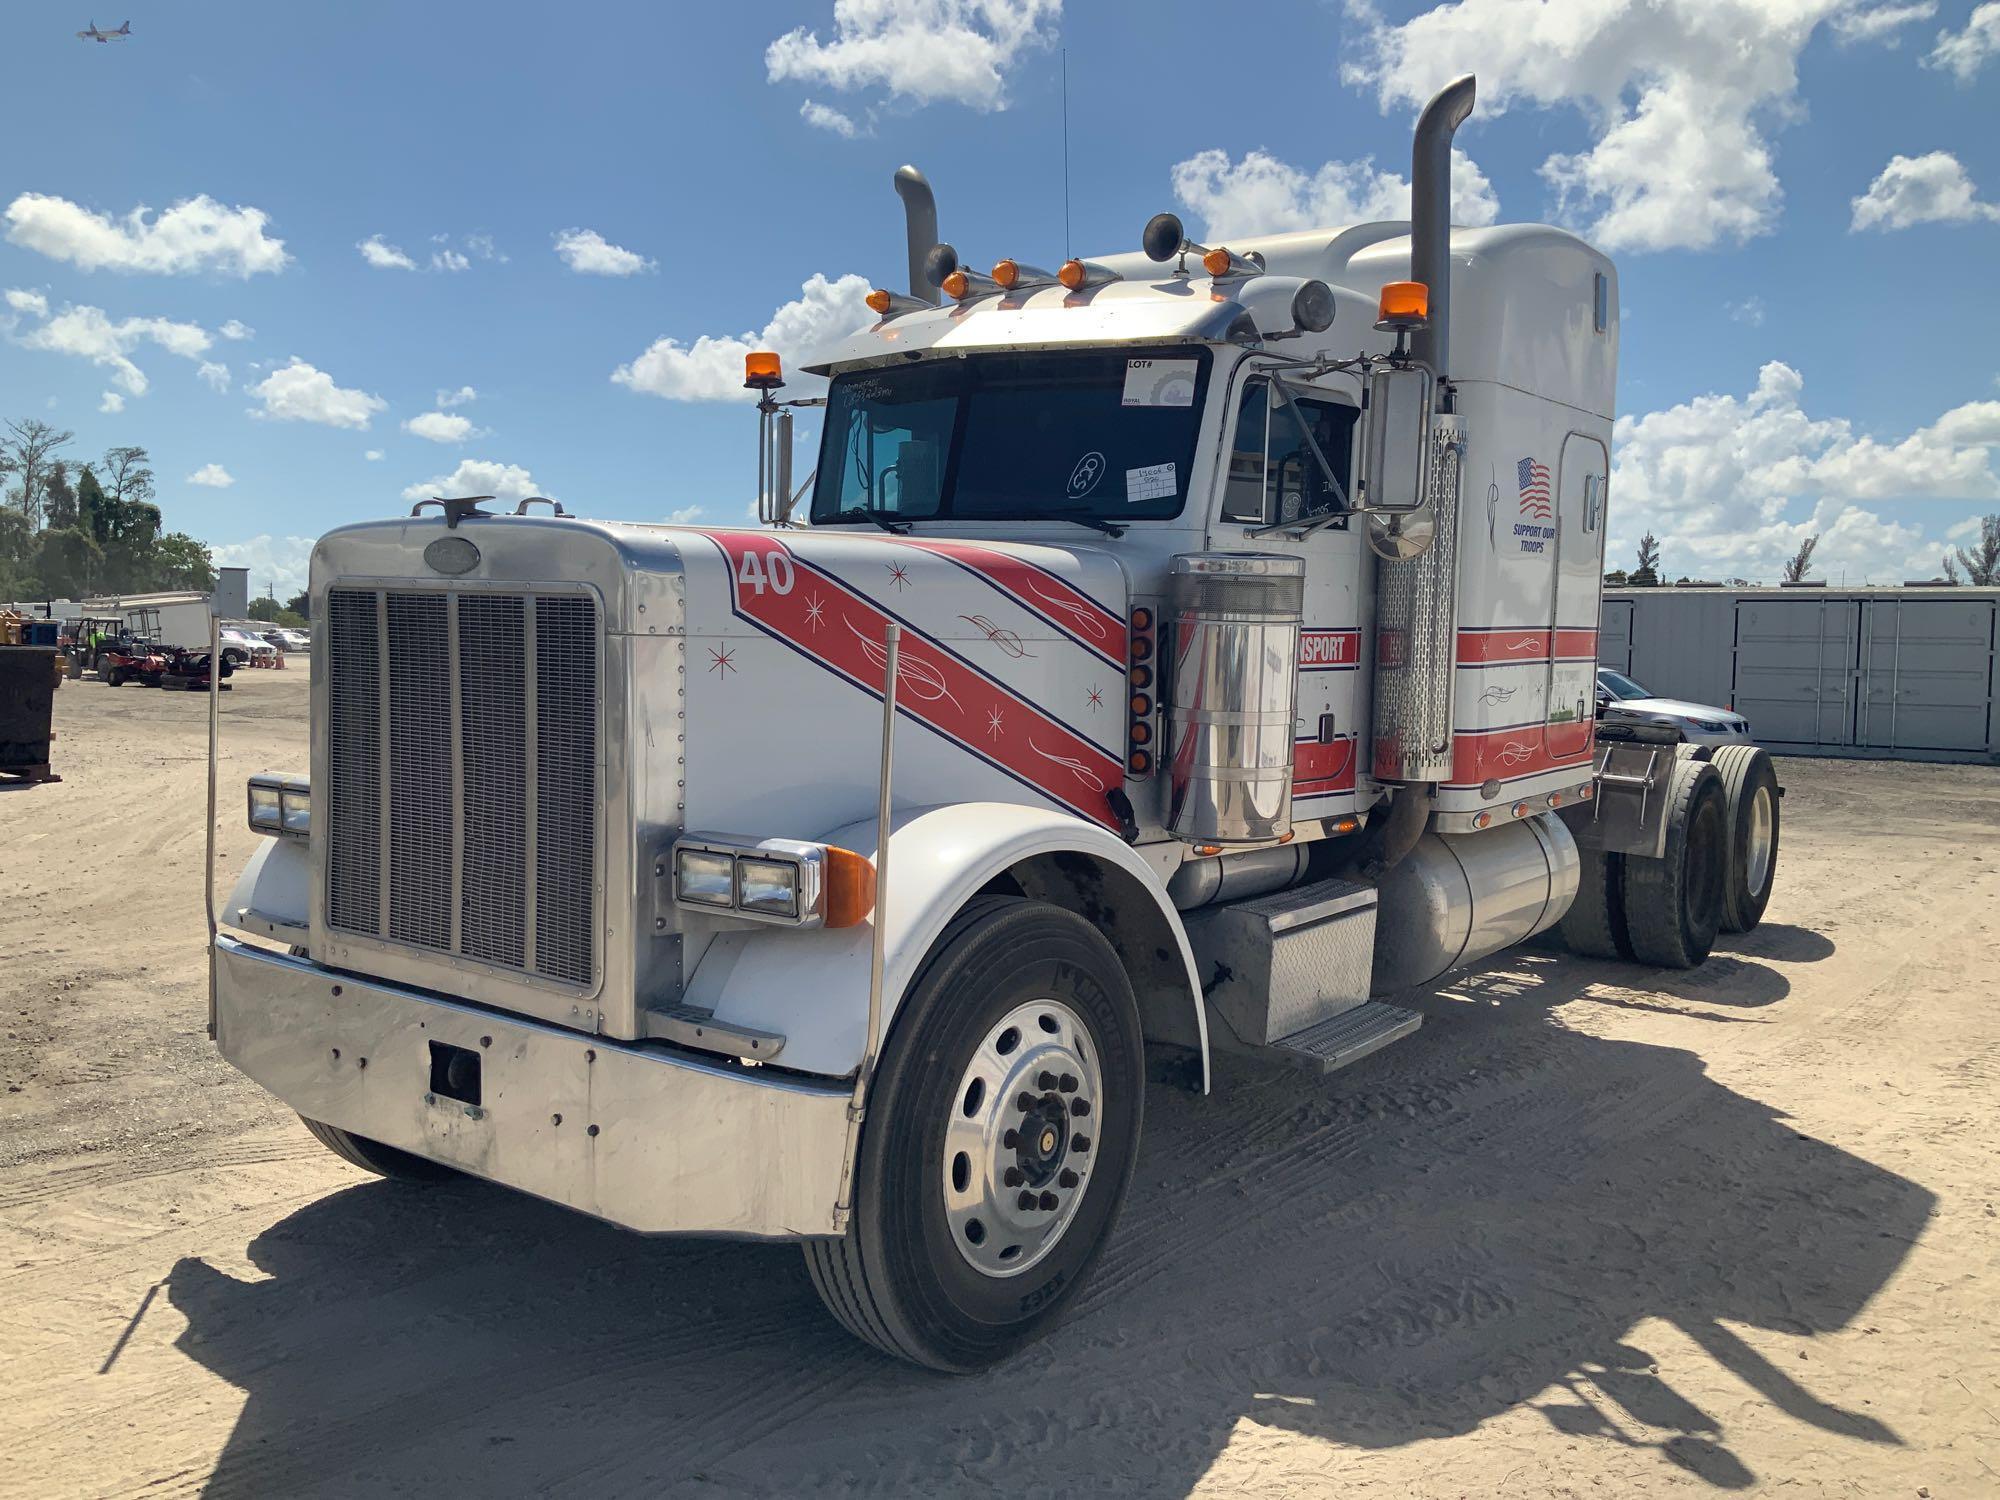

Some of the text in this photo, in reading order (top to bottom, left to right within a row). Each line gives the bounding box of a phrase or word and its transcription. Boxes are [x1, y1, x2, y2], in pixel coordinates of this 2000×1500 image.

[1129, 360, 1152, 369] LOT#
[1513, 523, 1555, 539] SUPPORT OUR
[1520, 540, 1544, 554] TROOPS
[739, 551, 795, 595] 40
